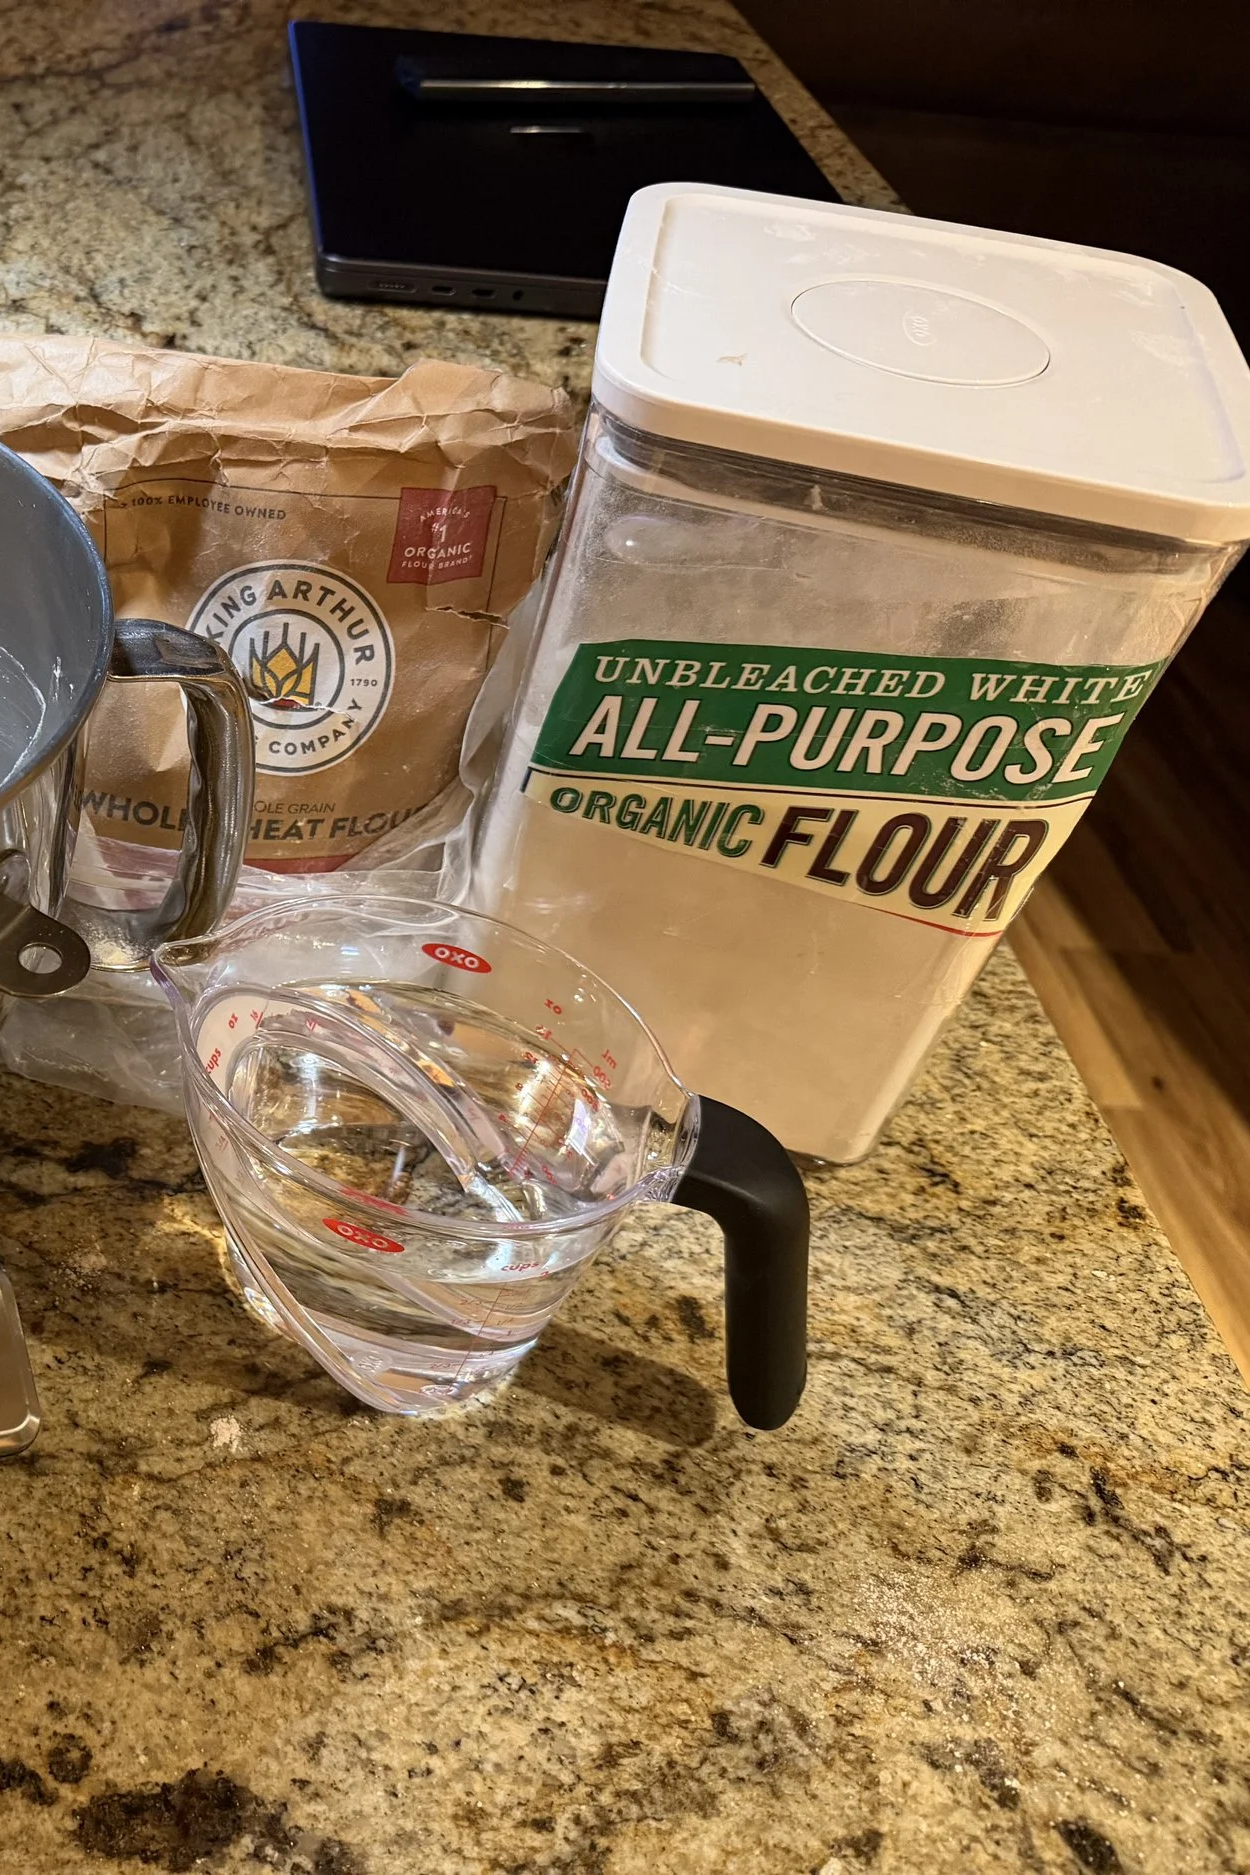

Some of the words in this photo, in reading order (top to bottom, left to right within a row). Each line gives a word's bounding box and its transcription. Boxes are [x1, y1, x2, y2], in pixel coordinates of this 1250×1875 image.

[132, 497, 162, 506] 100%
[168, 496, 230, 514] EMPLOYEE
[234, 505, 286, 520] OWNED
[404, 542, 471, 559] ORGANIC
[205, 585, 257, 645] KING
[267, 579, 375, 665] ARTHUR
[350, 678, 378, 687] 1790
[594, 655, 946, 700] UNBLEACHED
[969, 670, 1153, 704] WHITE
[268, 698, 362, 756] COMPANY
[568, 695, 1126, 785] ALL-PURPOSE
[254, 800, 284, 814] OLE
[288, 803, 336, 814] GRAIN
[250, 818, 325, 840] HEAT
[329, 808, 415, 838] FLOU
[549, 786, 765, 857] ORGANIC
[760, 806, 1050, 922] FLOUR
[434, 947, 479, 969] OXO
[337, 1224, 389, 1249] OXO
[501, 1261, 539, 1273] cups
